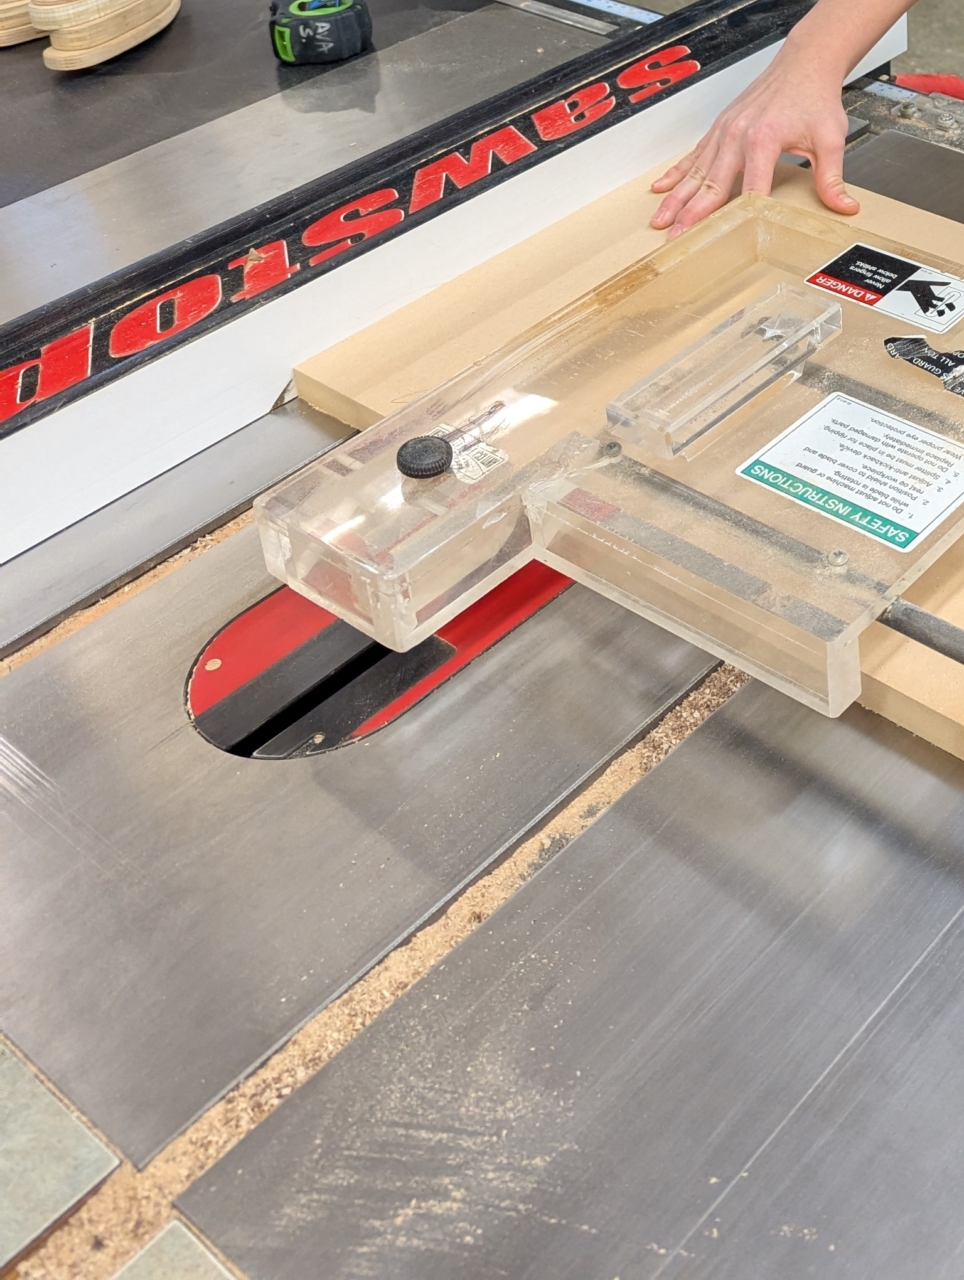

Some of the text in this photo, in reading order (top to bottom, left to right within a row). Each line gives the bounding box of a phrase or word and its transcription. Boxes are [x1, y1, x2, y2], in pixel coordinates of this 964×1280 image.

[315, 22, 335, 54] AVA
[849, 265, 891, 282] allow fingers
[877, 268, 897, 278] below
[815, 276, 864, 297] DANGER
[864, 278, 884, 288] Never
[939, 355, 956, 367] ALL
[831, 418, 850, 428] parts.
[870, 417, 906, 434] protection.
[823, 425, 847, 438] ripping.
[847, 426, 880, 442] damaged
[802, 446, 818, 454] and
[839, 442, 862, 455] device.
[858, 441, 878, 451] place
[880, 440, 896, 449] with
[918, 439, 943, 450] proper
[817, 452, 837, 464] blade
[896, 447, 924, 461] operate
[925, 451, 954, 467] Replace
[942, 449, 961, 460] Wear
[795, 462, 818, 473] guard
[837, 462, 857, 472] cover
[862, 453, 908, 476] anti-kickback
[895, 457, 914, 467] must
[937, 464, 948, 472] Do
[833, 470, 861, 485] rotating.
[861, 463, 897, 482] workpiece.
[913, 466, 940, 480] Splitter
[825, 475, 855, 491] machine
[865, 474, 888, 486] shield
[908, 474, 932, 487] Adjust
[854, 489, 878, 501] adjust
[869, 487, 889, 499] blade
[888, 484, 918, 500] Position
[908, 484, 924, 494] rest
[751, 465, 908, 541] SAFETY INSTRUCTIONS
[877, 499, 891, 507] not
[889, 496, 909, 507] while
[891, 505, 903, 514] Do
